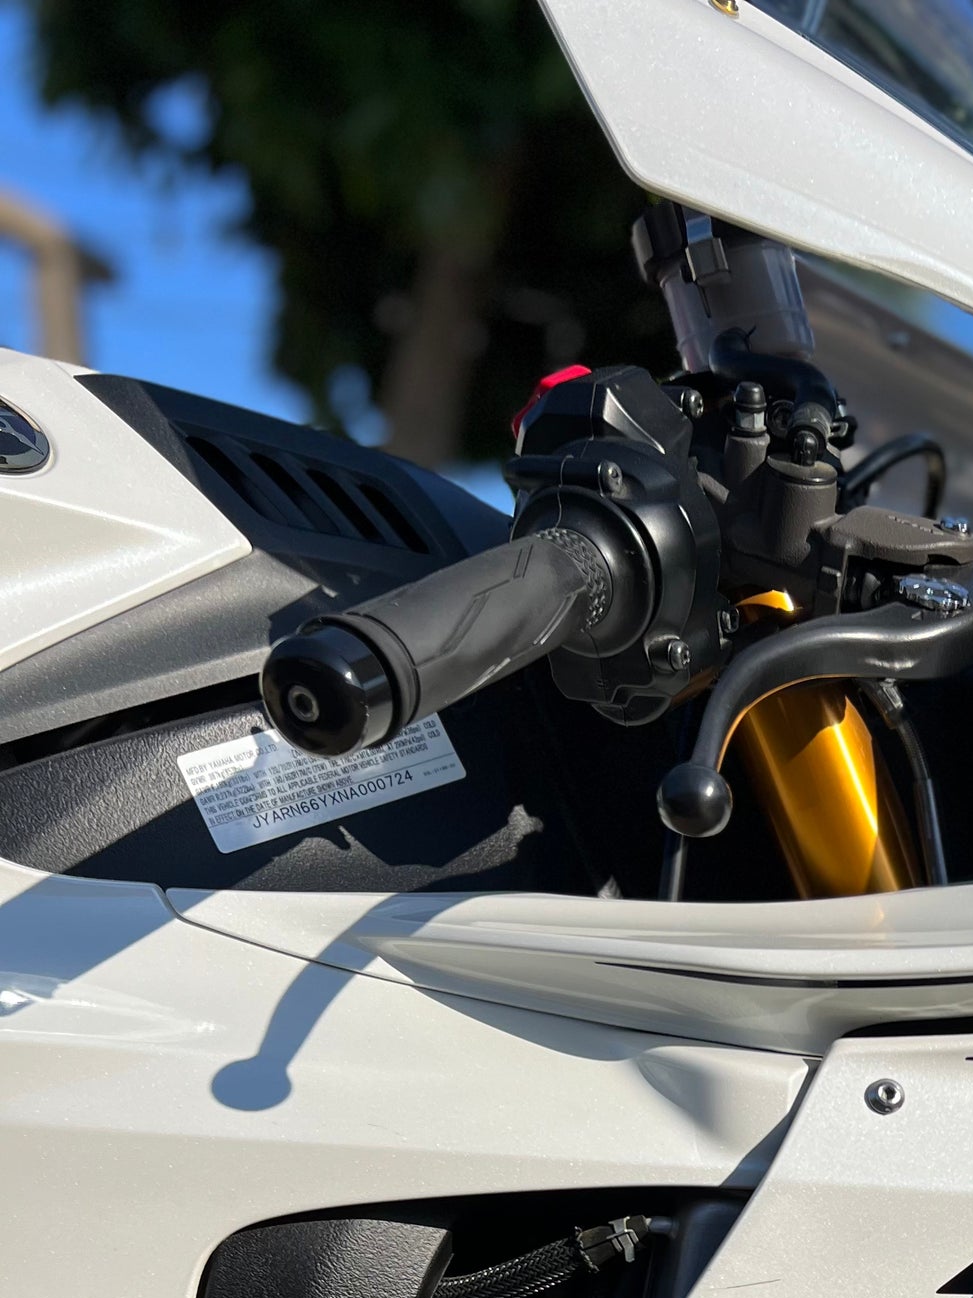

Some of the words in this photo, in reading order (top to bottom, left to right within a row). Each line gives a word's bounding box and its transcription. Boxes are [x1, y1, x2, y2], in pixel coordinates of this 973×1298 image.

[256, 800, 271, 813] DATE
[335, 775, 354, 787] ABOVE
[276, 784, 288, 794] ALL
[287, 775, 318, 791] APPLICABLE
[318, 769, 341, 781] FEDERAL
[379, 752, 399, 764] SAFETY
[253, 769, 413, 829] JYARN66YXNA000724
